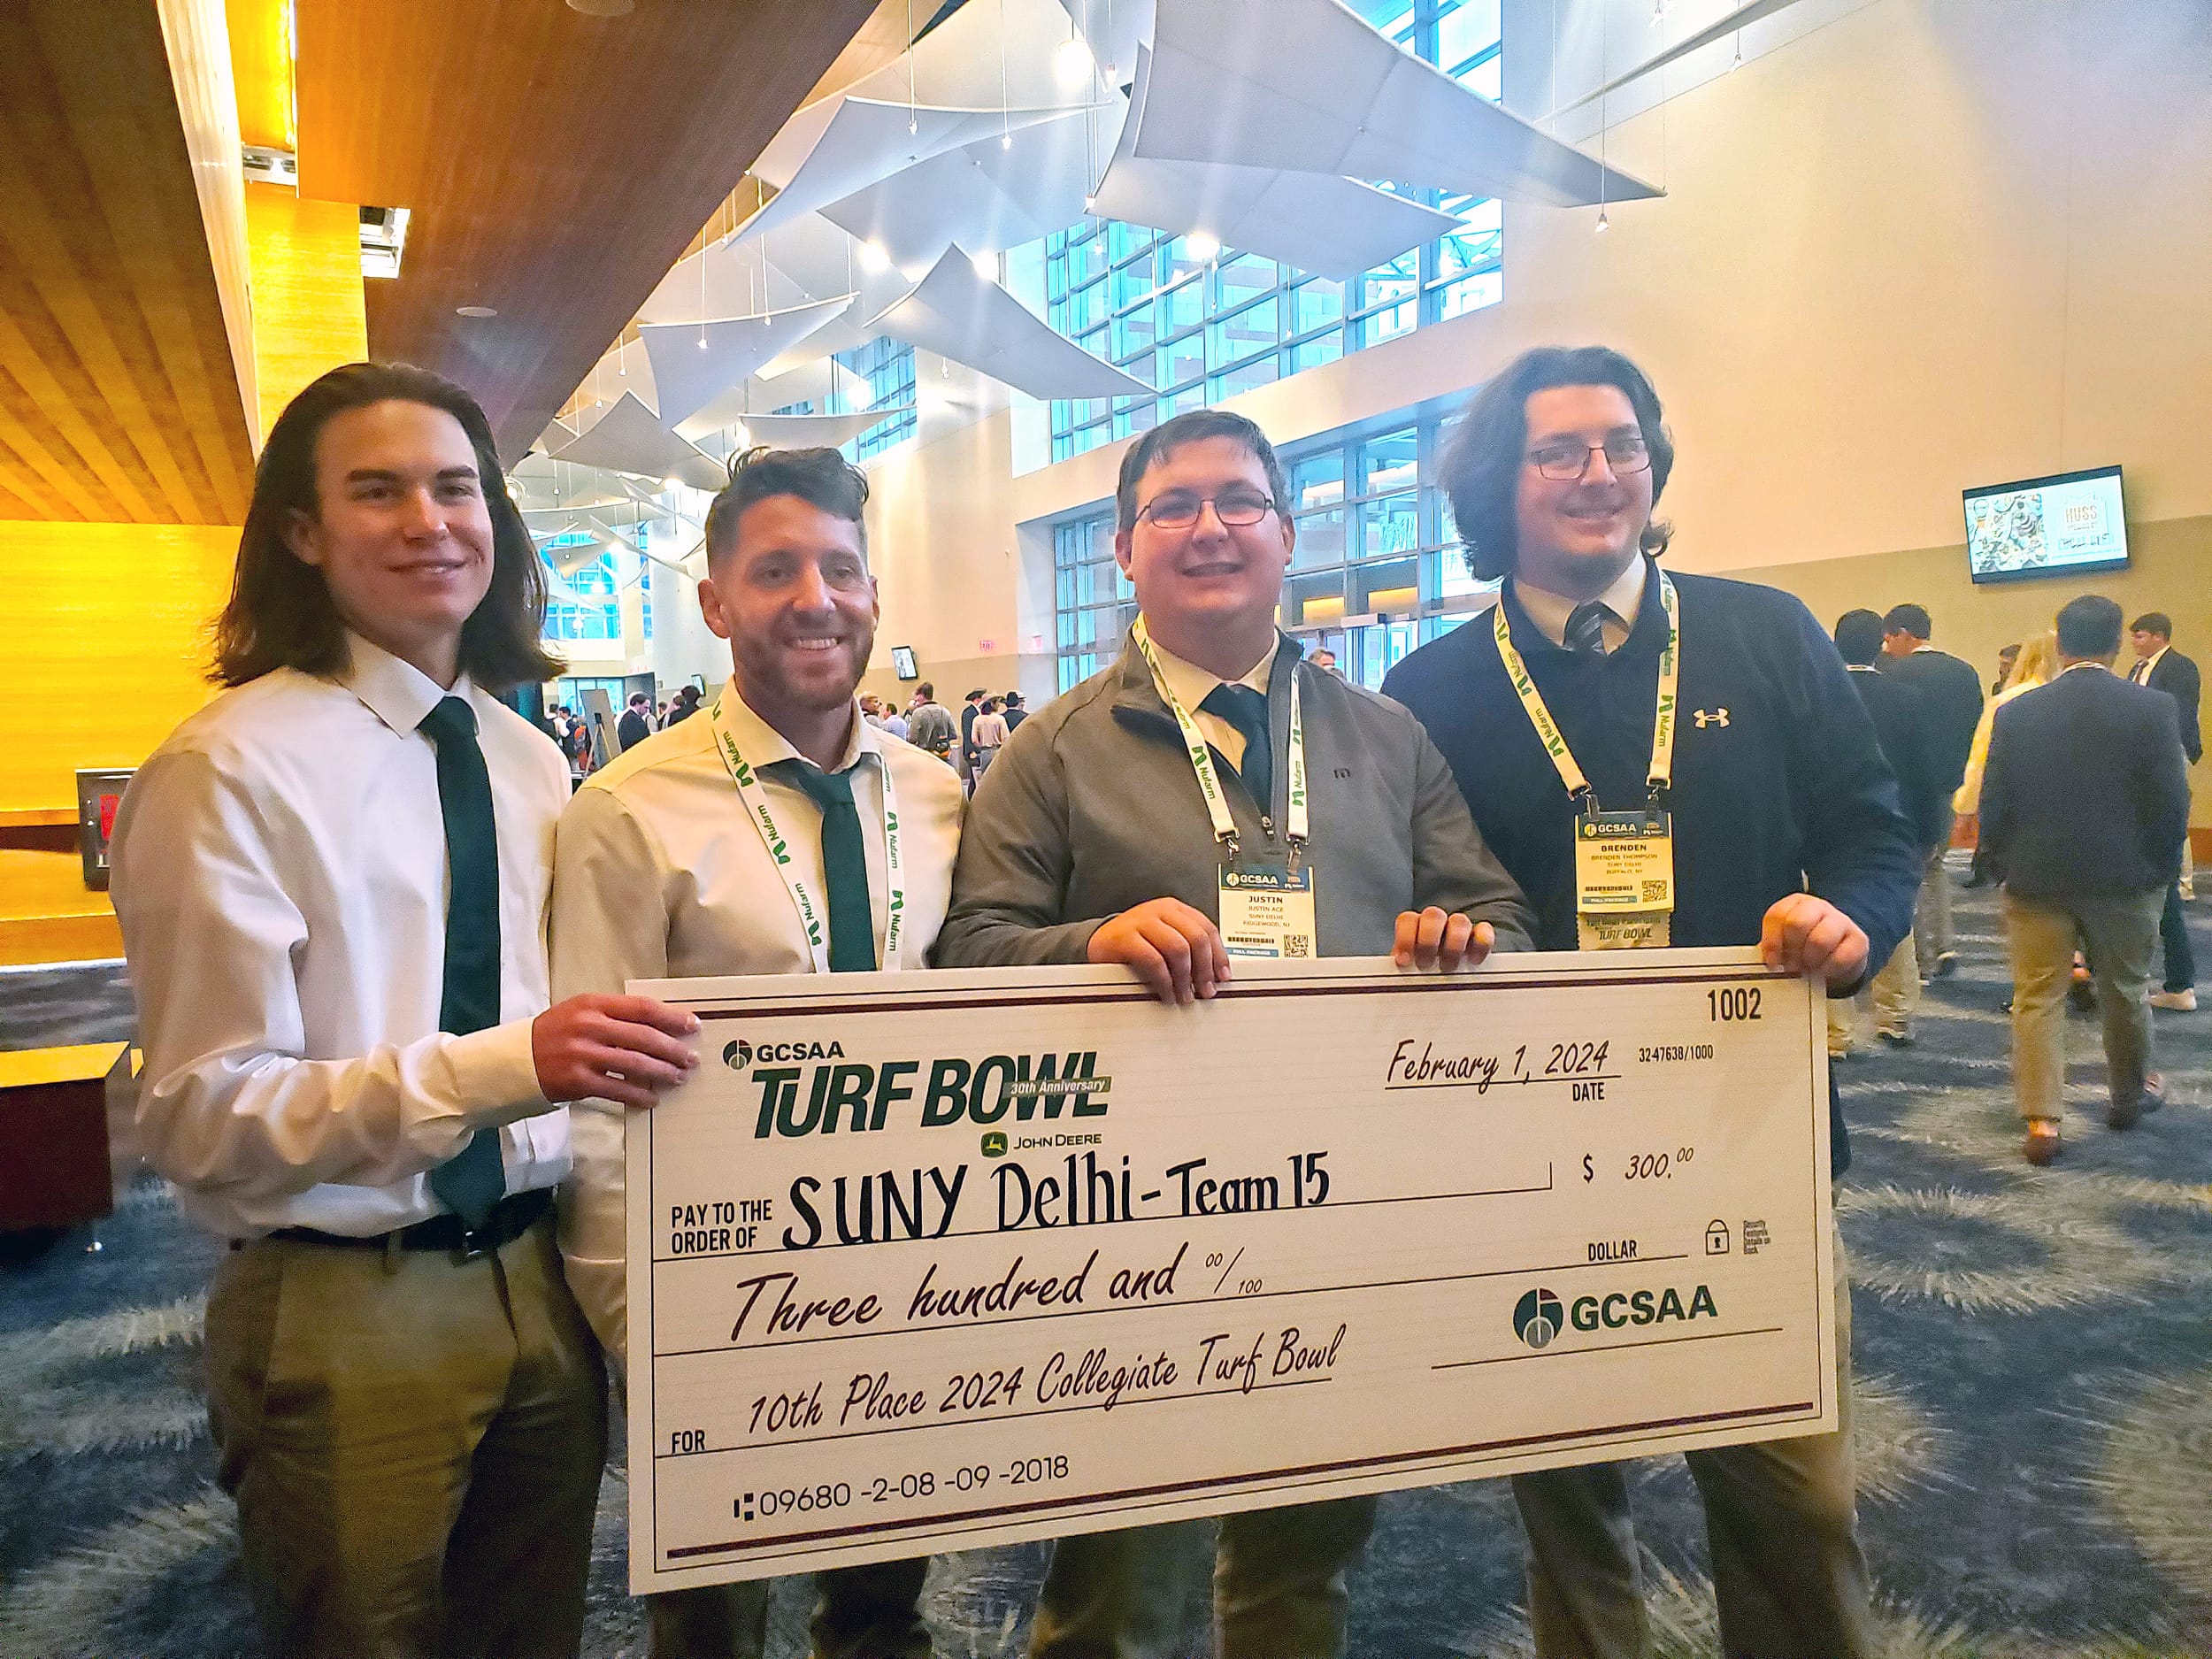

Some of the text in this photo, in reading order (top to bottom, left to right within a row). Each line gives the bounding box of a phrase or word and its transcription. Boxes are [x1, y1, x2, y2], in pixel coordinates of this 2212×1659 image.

[1536, 708, 1554, 739] Nufarm
[1659, 715, 1671, 747] Nufarm
[723, 731, 743, 764] Nufarm
[1200, 767, 1216, 800] Nufarm
[757, 804, 780, 841] Nufarm
[1598, 823, 1637, 833] GCSAA
[889, 834, 898, 869] Nufarm
[1601, 844, 1647, 853] BRENDEN
[1240, 874, 1279, 885] GCSAA
[795, 883, 815, 920] Nufarm
[889, 914, 901, 952] Nufarm
[1623, 927, 1653, 940] BOWL
[1707, 987, 1763, 1022] 1002
[757, 1041, 845, 1064] GCSAA
[1386, 1039, 1610, 1095] February 1, 2024
[1639, 1044, 1714, 1063] 3247638/1000
[751, 1051, 1110, 1140] TURF BOWL
[1010, 1079, 1106, 1095] 30th Anniversary
[1571, 1082, 1605, 1103] DATE
[1013, 1133, 1102, 1150] JOHN DEERE
[1583, 1153, 1594, 1184] $
[672, 1199, 773, 1229] PAY TO THE
[782, 1164, 968, 1249] SUNY
[1286, 1150, 1329, 1209] 15
[671, 1226, 758, 1255] ORDER OF
[1587, 1239, 1637, 1262] DOLLAR
[731, 1272, 883, 1341] Three
[907, 1249, 1099, 1320] hundred
[1110, 1241, 1189, 1302] and
[1571, 1285, 1718, 1332] GCSAA
[749, 1323, 1347, 1433] 10th Place 2024 Collegiate Turf Bowl
[671, 1430, 706, 1455] FOR
